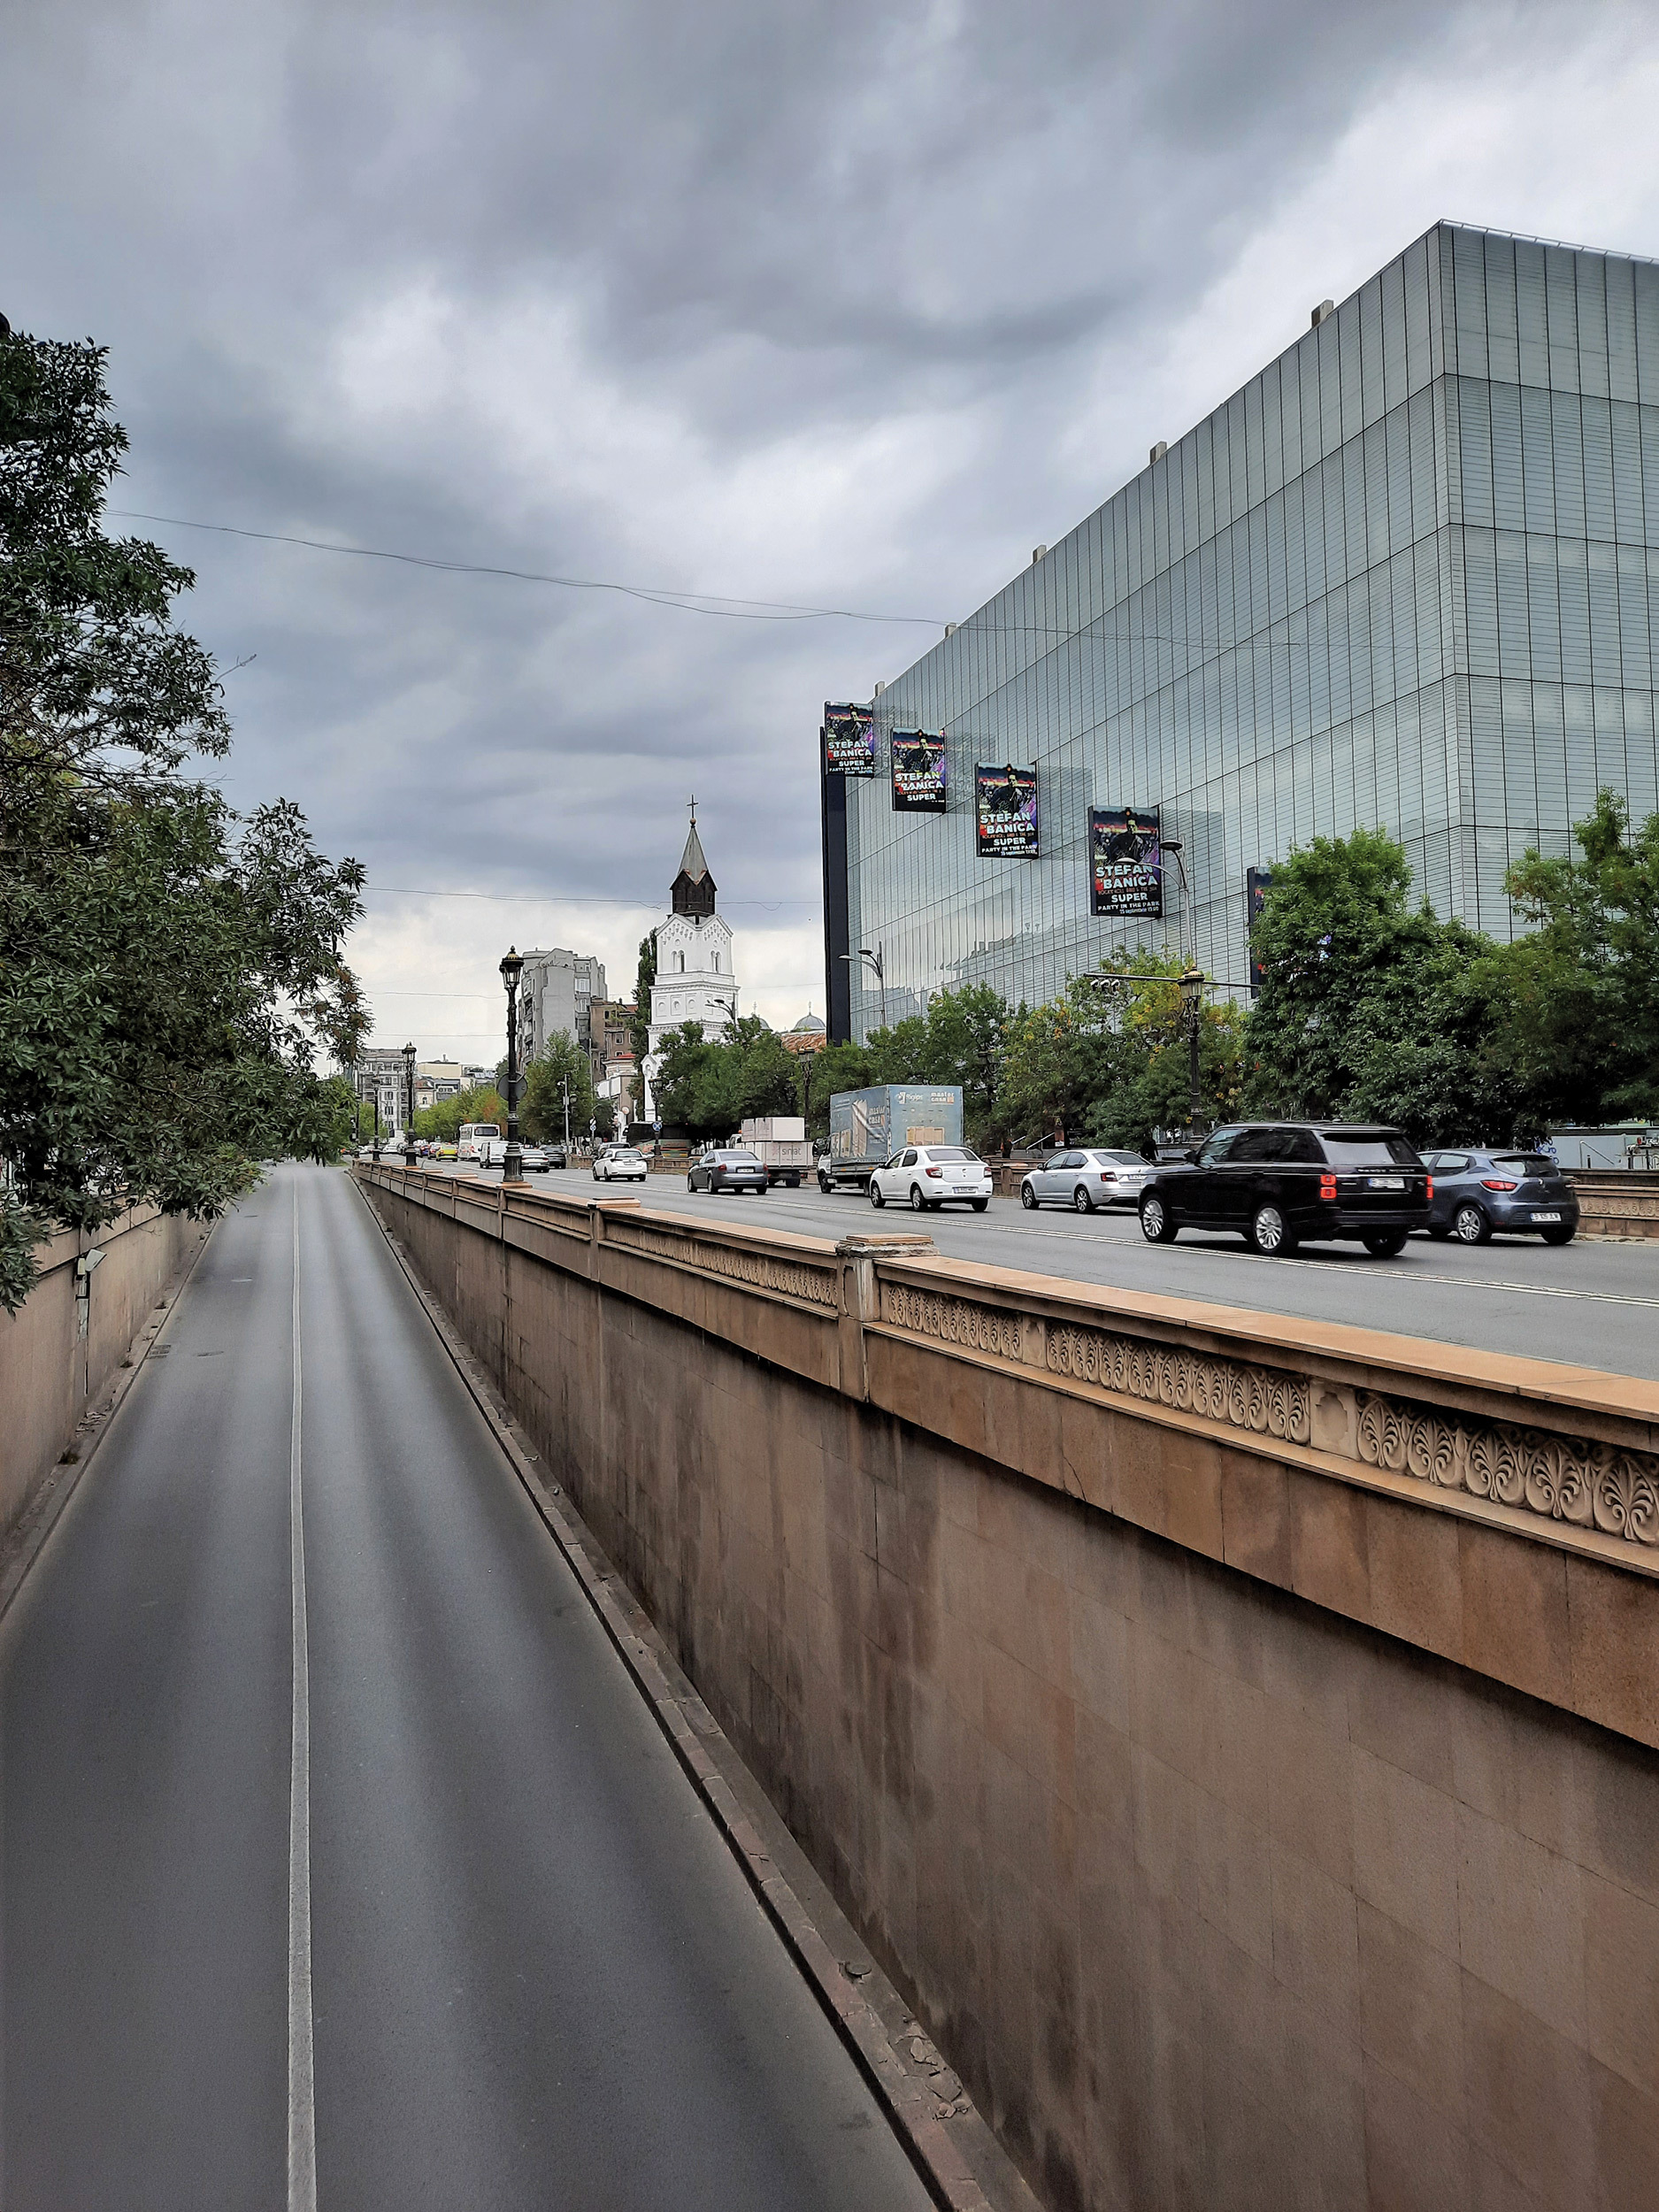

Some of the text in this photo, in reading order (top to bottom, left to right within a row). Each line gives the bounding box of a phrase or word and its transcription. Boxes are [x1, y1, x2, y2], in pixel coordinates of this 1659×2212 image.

[828, 741, 869, 749] STEFAN
[895, 772, 940, 781] STEFAN
[980, 812, 1031, 824] STEFAN
[987, 823, 1035, 833] BANICA
[994, 837, 1025, 846] SUPER
[1096, 864, 1153, 877] STEFAN
[1103, 876, 1157, 889] BANICA
[1111, 892, 1148, 902] SUPER
